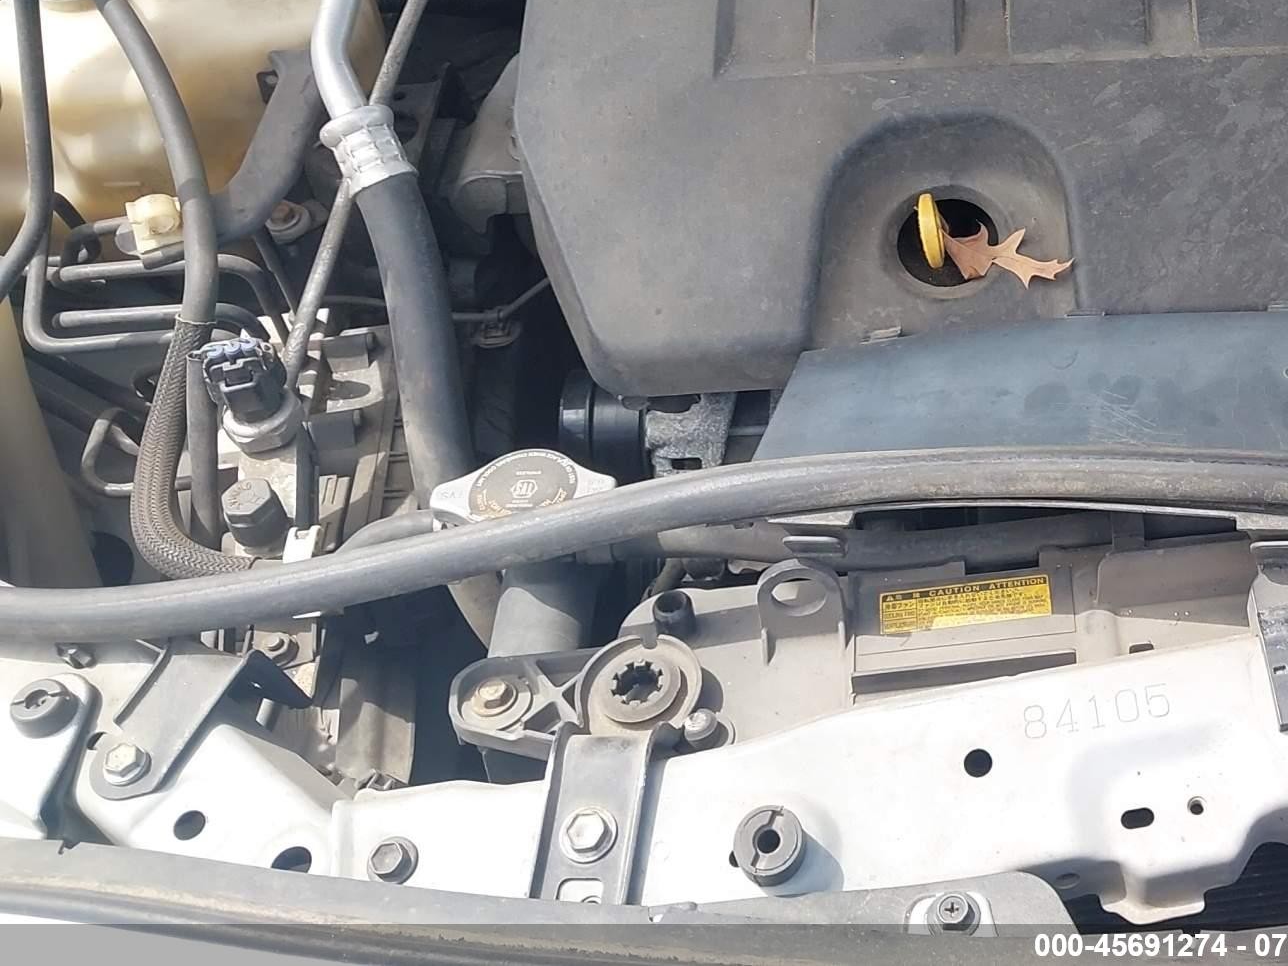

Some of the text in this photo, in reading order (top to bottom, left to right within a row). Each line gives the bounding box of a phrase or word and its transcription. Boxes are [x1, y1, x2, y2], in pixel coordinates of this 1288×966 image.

[928, 585, 980, 598] CAUTION
[988, 577, 1044, 591] ATTENTION
[1023, 682, 1170, 739] 84105
